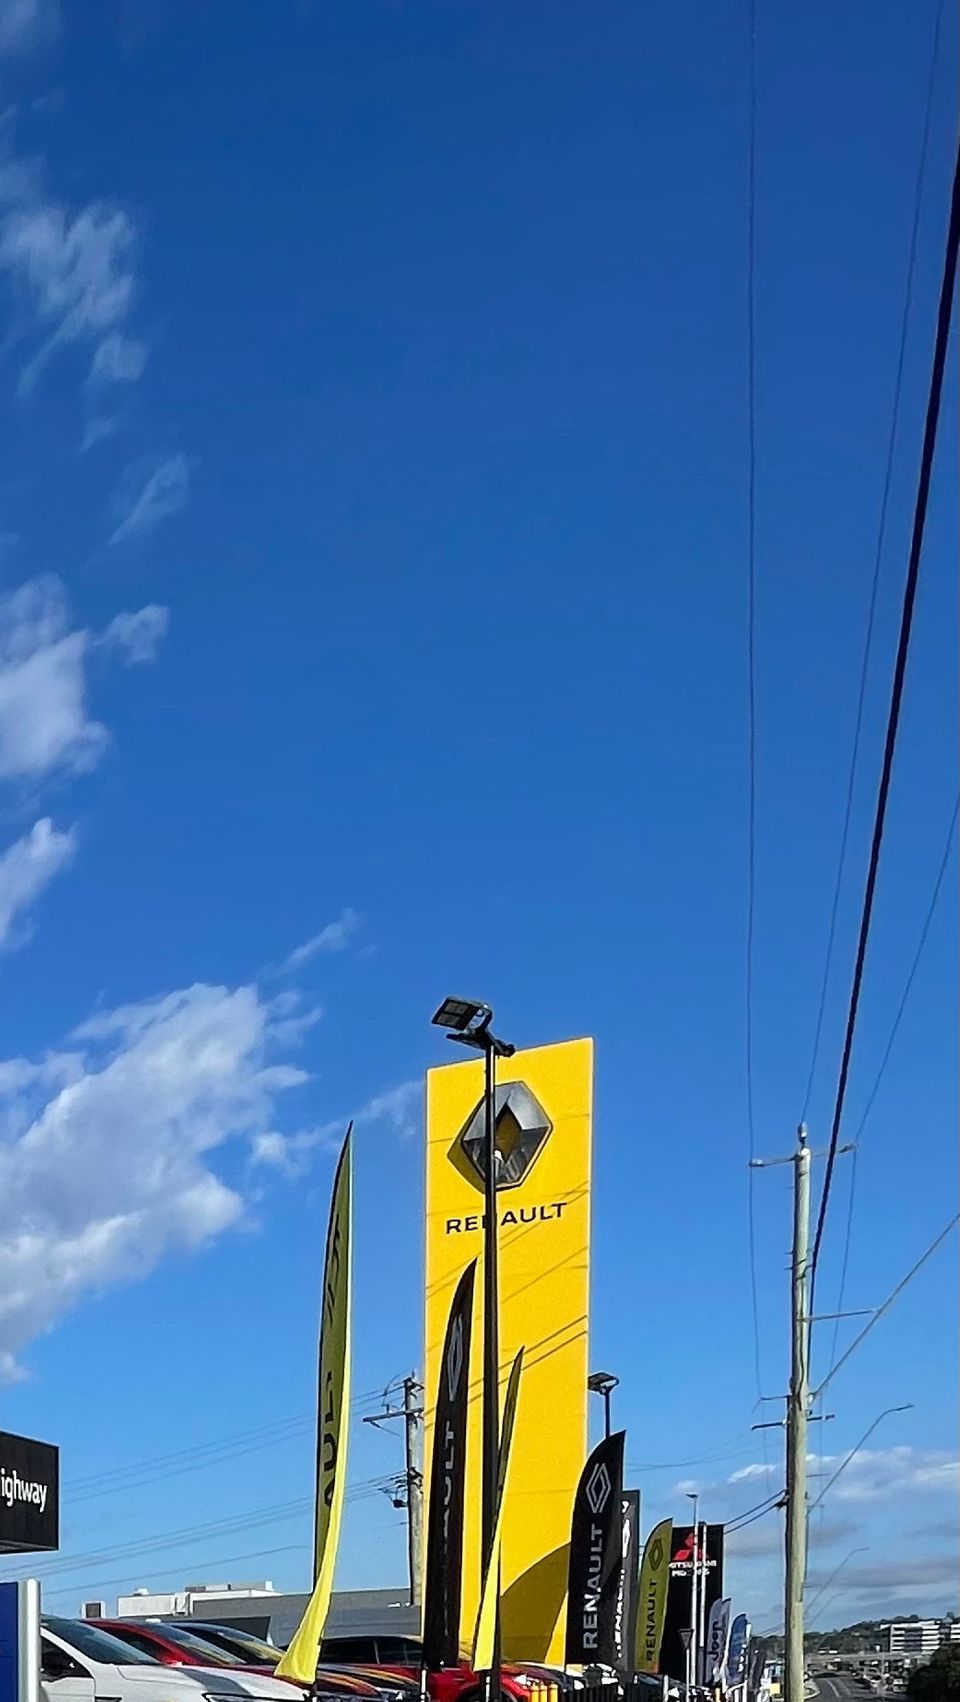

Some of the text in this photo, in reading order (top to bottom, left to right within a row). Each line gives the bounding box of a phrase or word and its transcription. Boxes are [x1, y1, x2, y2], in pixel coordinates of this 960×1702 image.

[446, 1202, 568, 1235] REAULT
[582, 1523, 603, 1649] RENAULT
[645, 1579, 658, 1662] RENAULT
